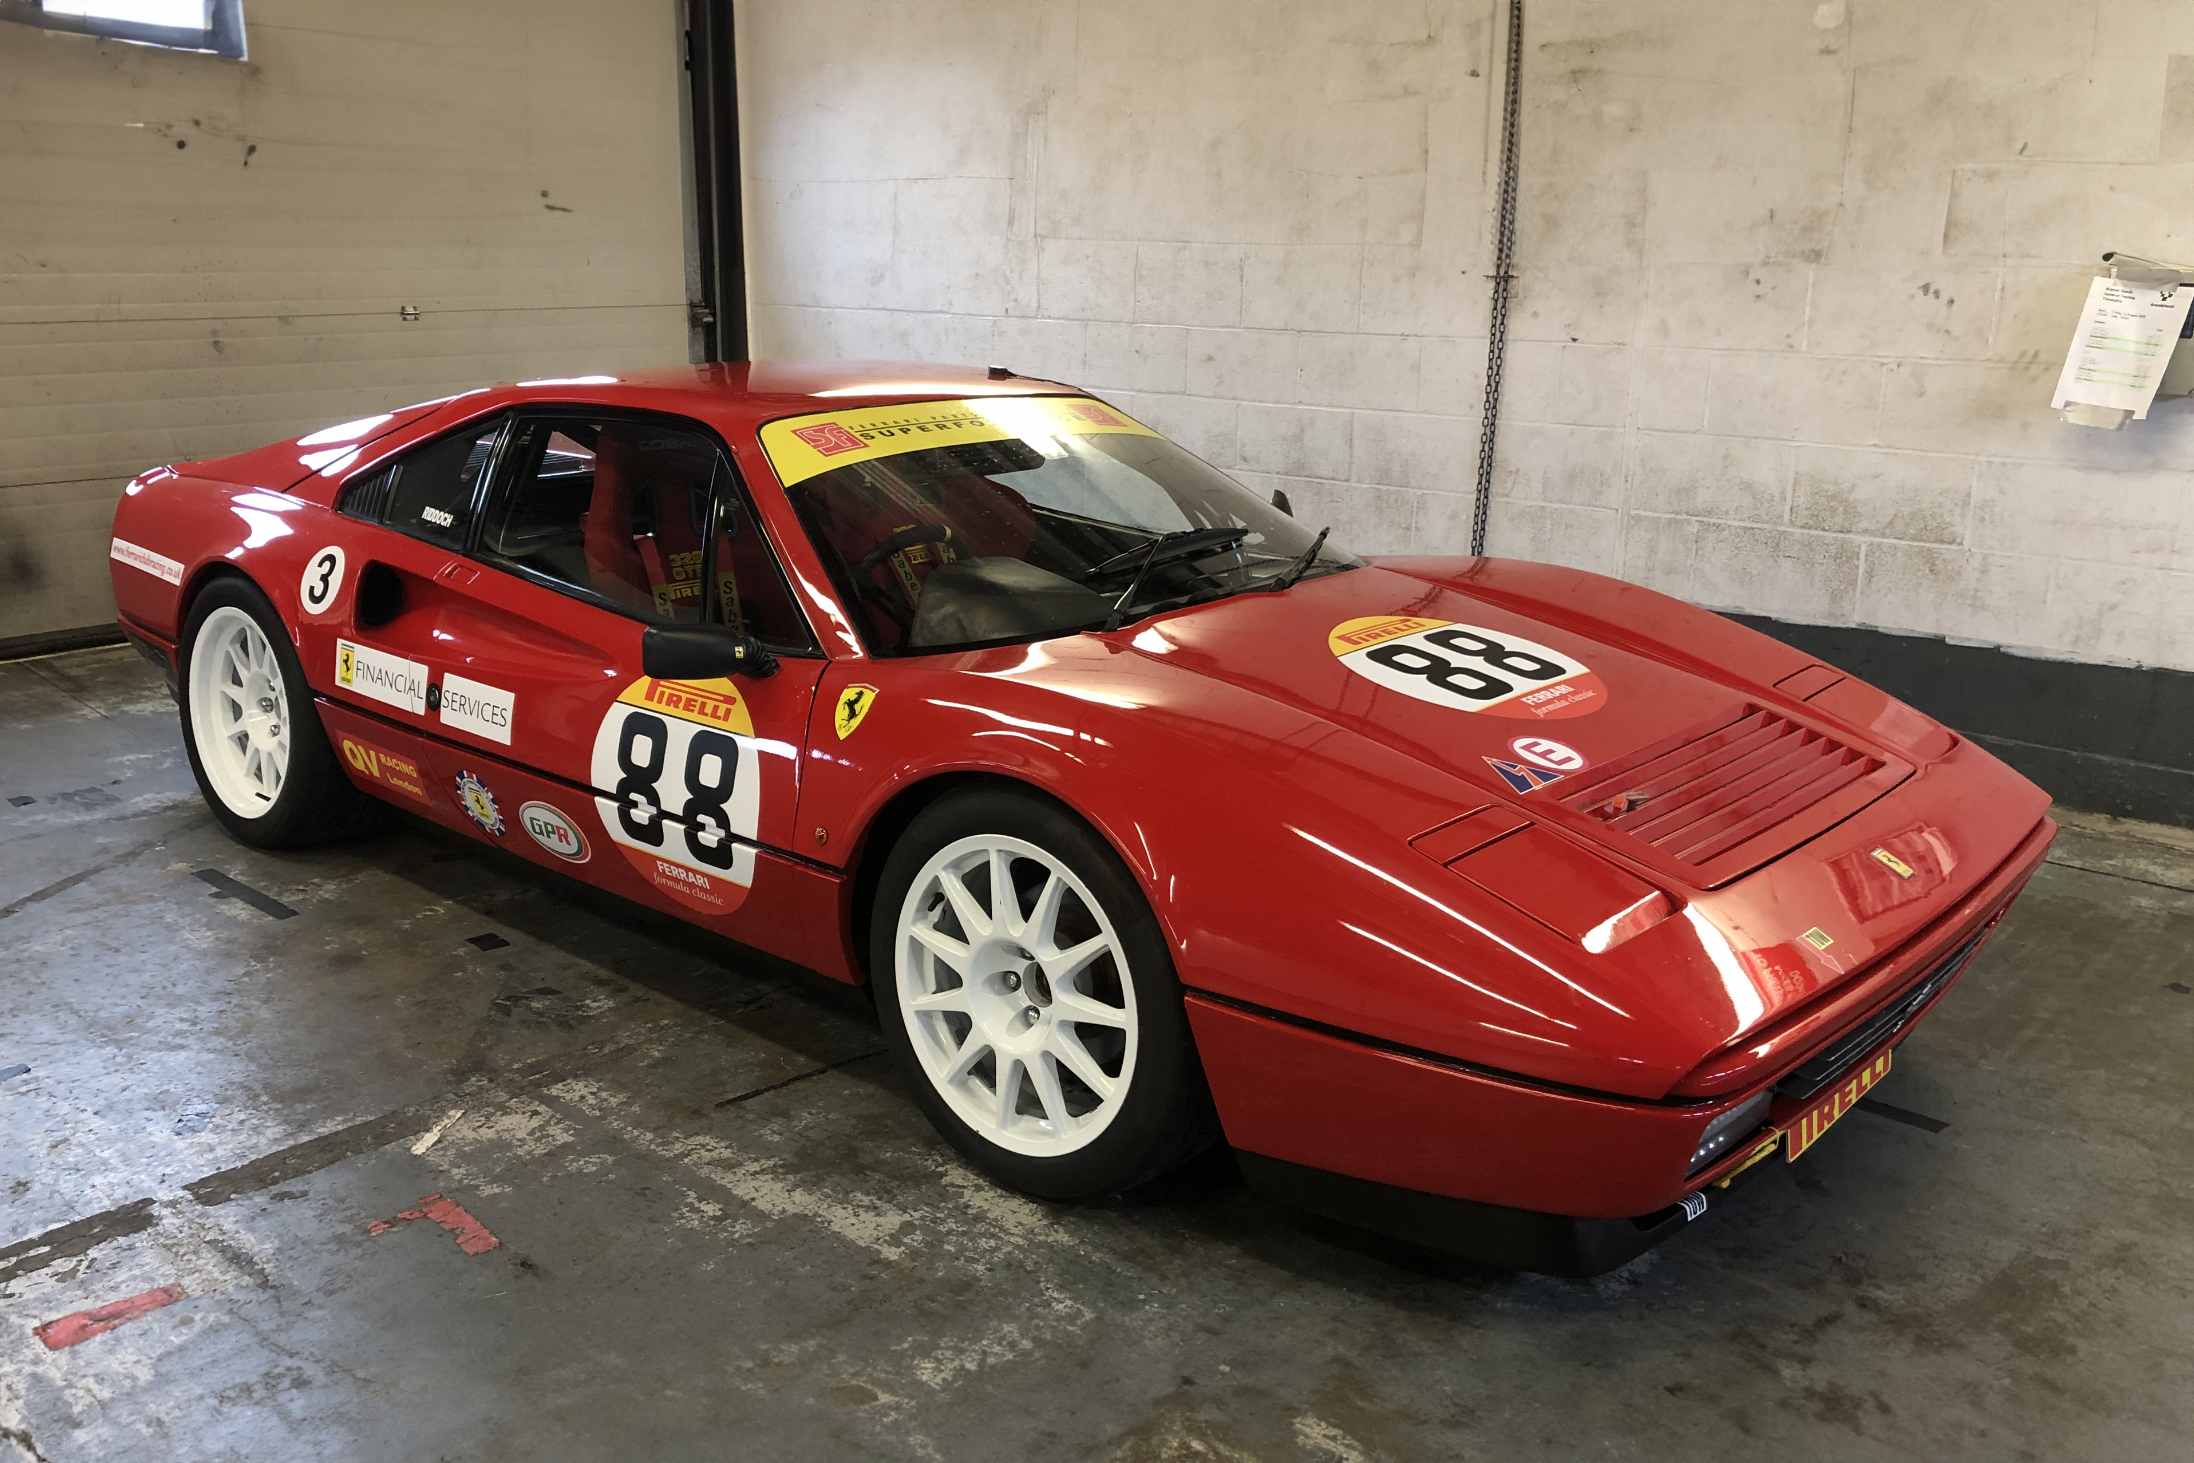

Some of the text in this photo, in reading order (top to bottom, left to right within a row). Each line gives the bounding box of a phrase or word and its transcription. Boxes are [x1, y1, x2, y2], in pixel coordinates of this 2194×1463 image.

[848, 417, 920, 431] FERRARI
[421, 505, 454, 528] RIDDOCH
[309, 554, 336, 605] 3
[1334, 618, 1428, 646] PIRELLI
[1365, 629, 1567, 701] 88
[355, 660, 508, 728] FINANCIAL SERVICES
[644, 679, 737, 723] PIRELLI
[1520, 684, 1576, 706] FERRARI
[1530, 689, 1598, 718] formula classic
[342, 739, 418, 778] QV RACING
[1518, 741, 1576, 767] E
[386, 773, 423, 796] London
[616, 711, 739, 871] 88
[529, 816, 572, 847] GPR
[653, 872, 724, 907] formula classic
[656, 860, 711, 890] FERRARI
